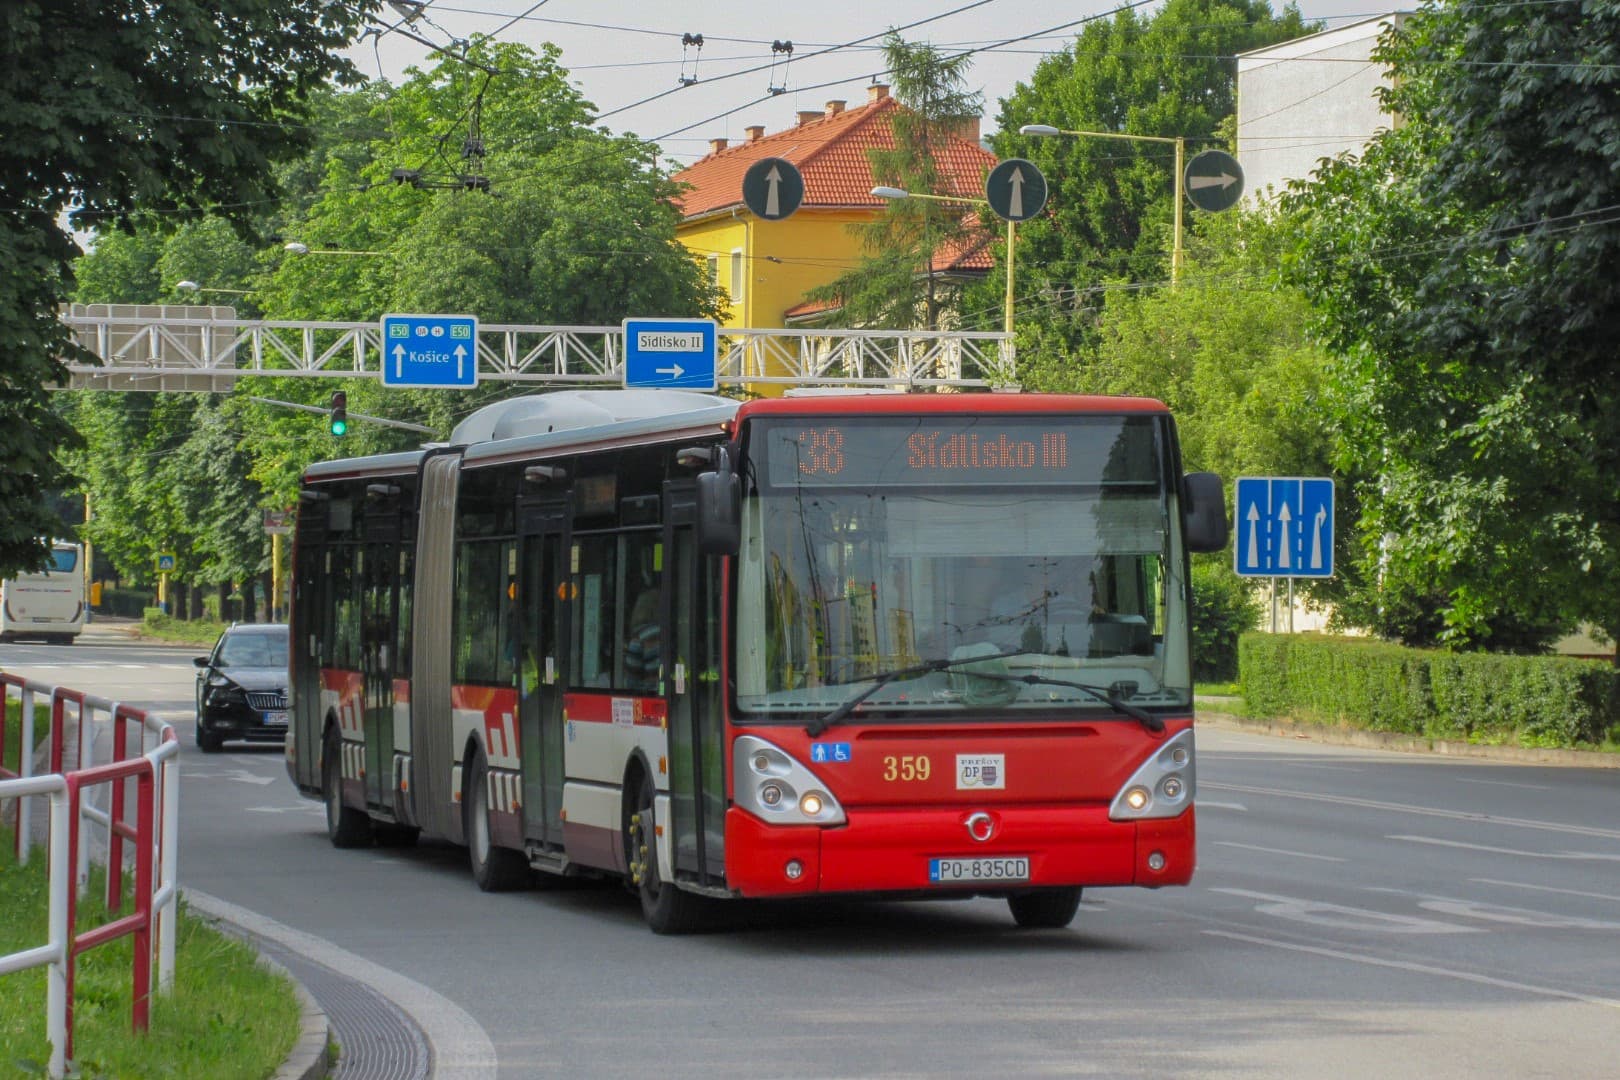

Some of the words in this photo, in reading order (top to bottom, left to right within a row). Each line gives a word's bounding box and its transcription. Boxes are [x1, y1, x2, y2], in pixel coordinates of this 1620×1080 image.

[391, 326, 407, 336] E50
[452, 327, 468, 337] E50
[641, 334, 687, 348] Sídlisko
[691, 336, 700, 348] II
[409, 350, 450, 363] Košice
[798, 427, 846, 475] 38
[907, 431, 1036, 469] Sídlisko
[883, 755, 931, 781] 359
[964, 766, 980, 778] DP
[941, 860, 1026, 878] PO-835CD
